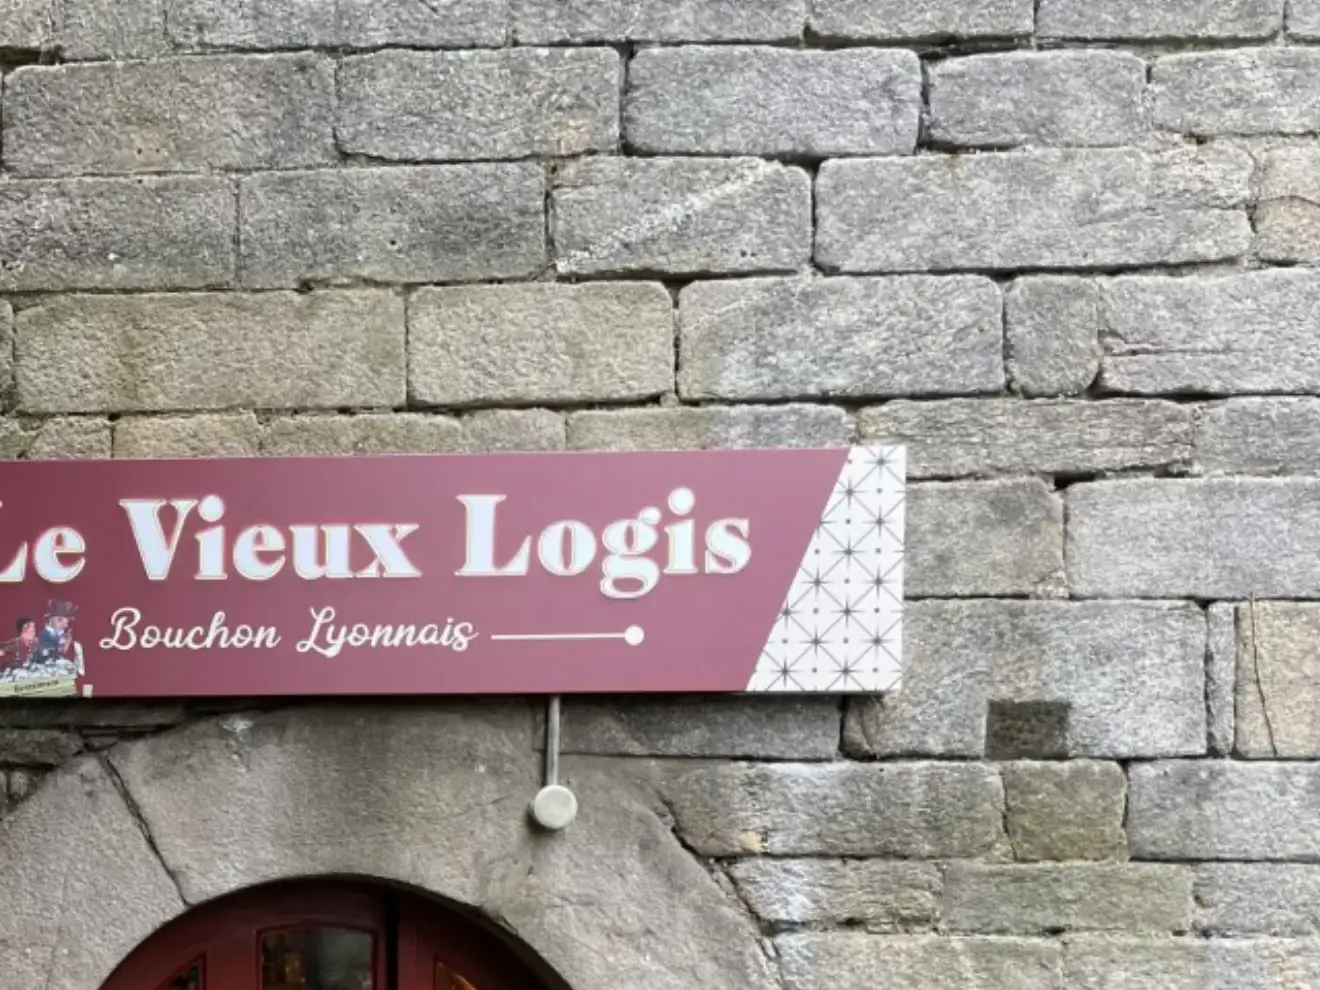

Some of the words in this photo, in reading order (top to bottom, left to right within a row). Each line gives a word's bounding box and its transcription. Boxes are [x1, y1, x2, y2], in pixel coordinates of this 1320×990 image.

[119, 493, 424, 581] Vieux
[455, 486, 753, 600] Logis
[97, 605, 282, 652] Bouchon
[293, 604, 481, 660] Lyonnais
